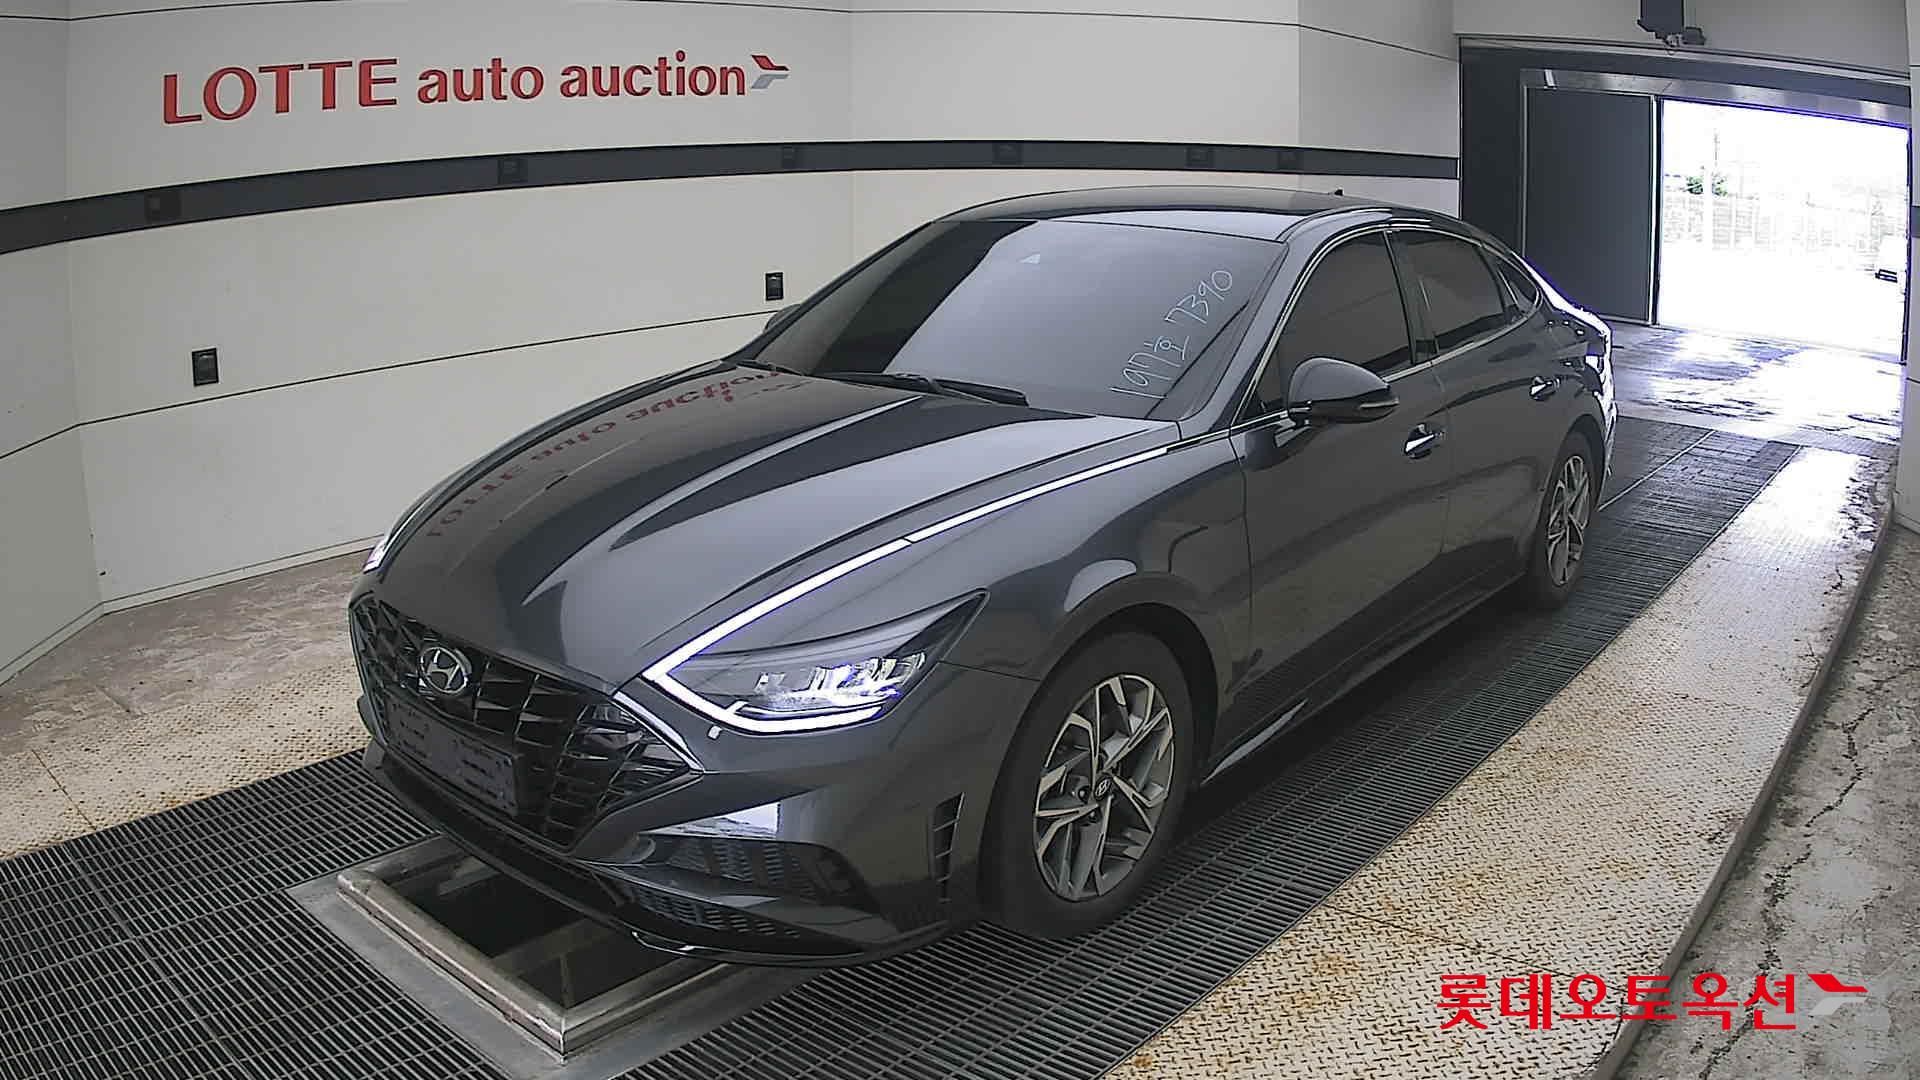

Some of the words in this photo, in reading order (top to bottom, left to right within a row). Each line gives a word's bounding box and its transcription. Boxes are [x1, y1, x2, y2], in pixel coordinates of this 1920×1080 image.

[163, 58, 398, 125] LOTTE
[417, 57, 545, 104] auto
[559, 50, 746, 98] auction
[1164, 269, 1233, 325] 7390
